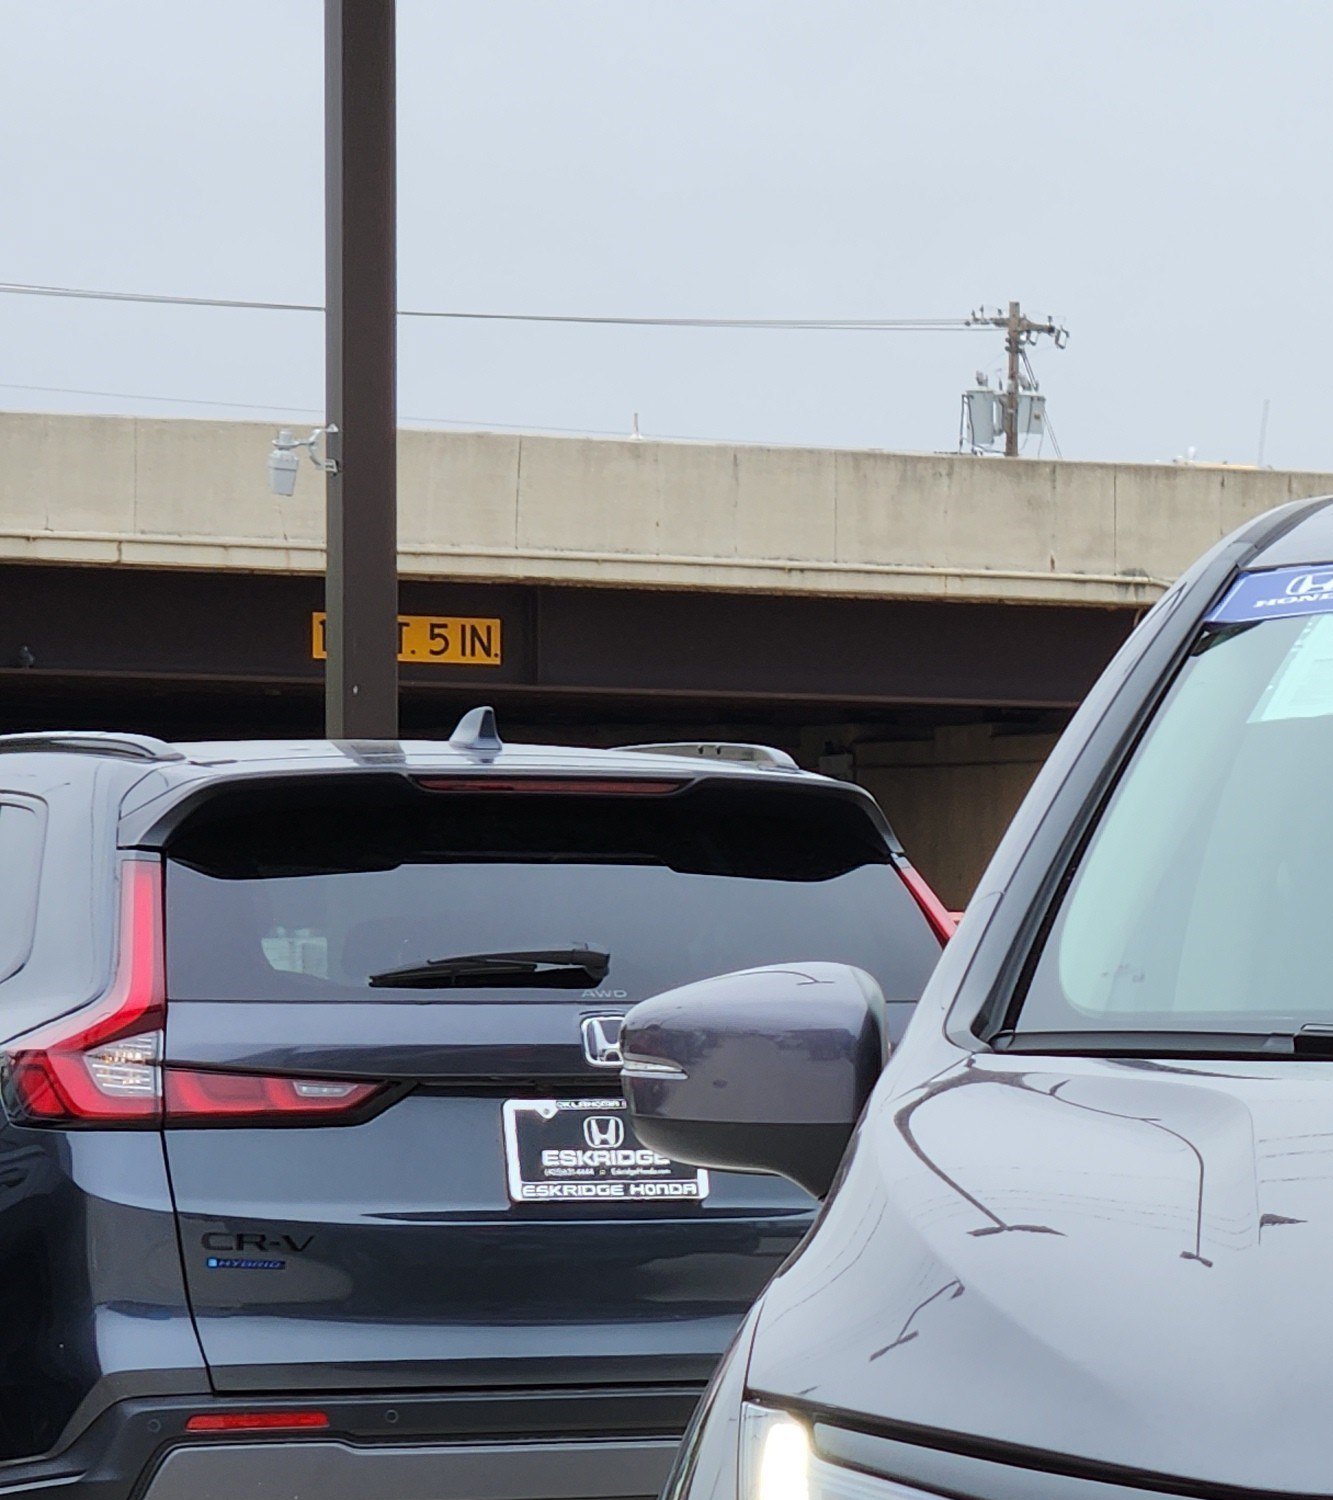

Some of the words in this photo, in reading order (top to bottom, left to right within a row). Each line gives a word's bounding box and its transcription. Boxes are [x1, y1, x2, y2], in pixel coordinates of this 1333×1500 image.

[429, 622, 450, 657] 5
[460, 624, 500, 658] IN.
[582, 989, 628, 998] AWD
[541, 1149, 671, 1167] ESKRIDGE
[522, 1183, 625, 1197] ESKRIDGE
[629, 1182, 698, 1196] HONDA
[201, 1231, 316, 1252] CR-V
